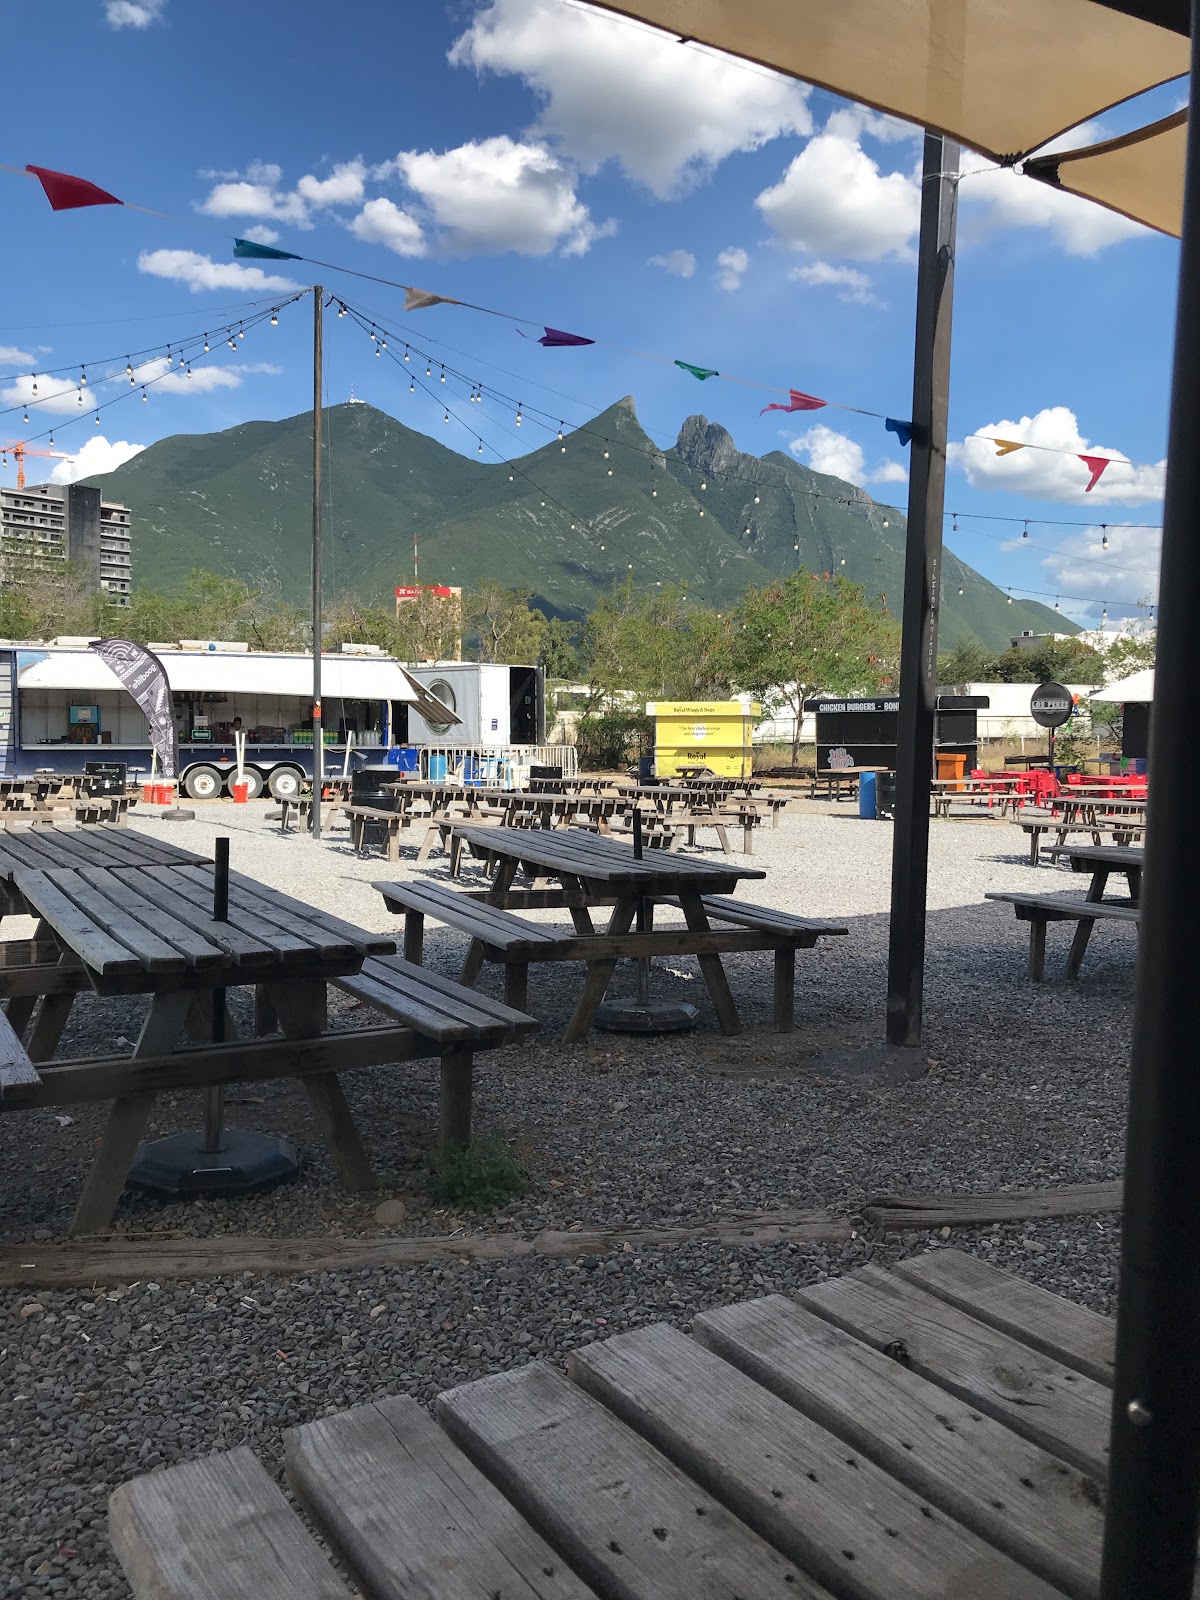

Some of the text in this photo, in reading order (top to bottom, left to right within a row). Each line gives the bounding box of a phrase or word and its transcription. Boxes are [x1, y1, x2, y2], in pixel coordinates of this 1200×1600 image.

[819, 703, 846, 711] CHICKEN
[847, 703, 876, 711] BURGERS
[687, 752, 706, 761] Royal
